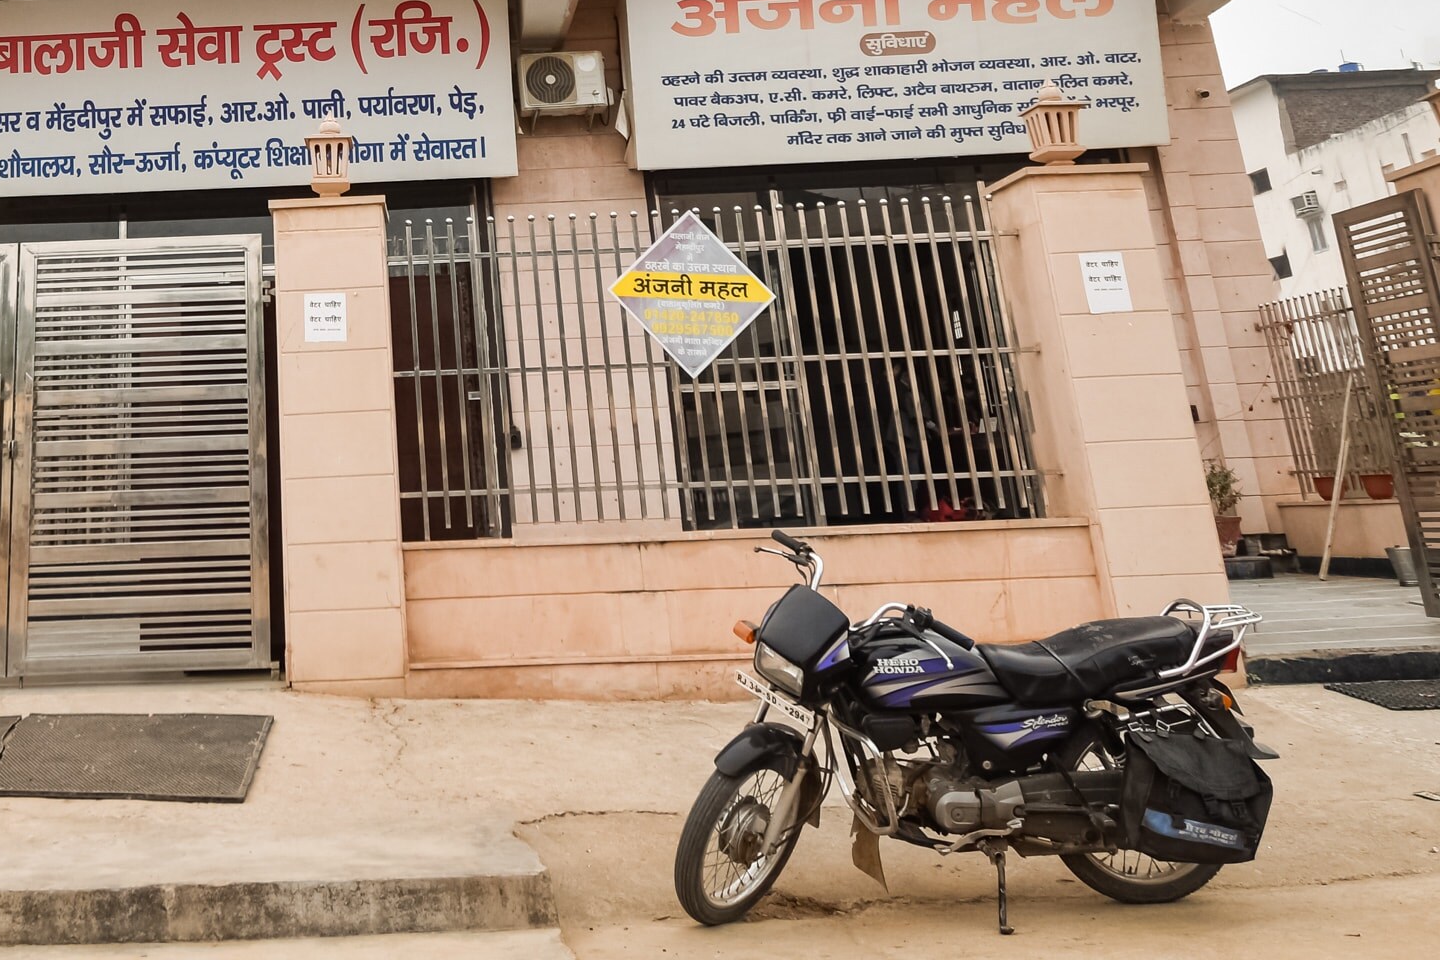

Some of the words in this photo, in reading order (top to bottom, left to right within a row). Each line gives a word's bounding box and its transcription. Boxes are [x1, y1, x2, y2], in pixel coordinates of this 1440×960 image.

[157, 12, 243, 67] सेवा
[253, 21, 337, 81] ट्रस्ट
[866, 32, 930, 54] सुविधाएं
[661, 71, 700, 87] ठहरने
[704, 69, 724, 84] की
[728, 70, 767, 83] उत्तम
[771, 68, 827, 81] व्यवस्था,
[832, 65, 859, 83] शुद्ध
[864, 59, 928, 77] शाकाहारी
[931, 58, 975, 74] भोजन
[979, 56, 1036, 71] व्यवस्था,
[1040, 54, 1072, 68] आर.
[1076, 51, 1100, 66] ओ.
[1104, 51, 1142, 65] वाटर,
[673, 95, 707, 107] पावर
[710, 91, 764, 106] बैकअप,
[768, 88, 807, 103] ए.सी.
[811, 86, 852, 101] कमरे,
[856, 84, 898, 99] लिफ्ट,
[903, 81, 936, 97] अटैच
[1092, 72, 1133, 87] कमरे,
[25, 111, 41, 131] व
[46, 100, 123, 140] मेंहदीपुर
[126, 98, 147, 127] में
[149, 94, 213, 128] सफाई,
[220, 92, 296, 123] आर.ओ.
[302, 89, 352, 119] पानी,
[358, 87, 442, 117] पर्यावरण,
[448, 85, 485, 120] पेड़,
[671, 118, 686, 129] 24
[689, 114, 711, 129] घंटे
[714, 111, 765, 127] बिजली,
[850, 104, 914, 122] वाई-फाई
[918, 100, 948, 118] सभी
[952, 100, 1013, 120] आधुनिक
[1095, 95, 1140, 115] भरपूर,
[786, 130, 823, 146] मंदिर
[826, 132, 852, 144] तक
[857, 128, 886, 142] आने
[891, 125, 922, 141] जाने
[926, 124, 946, 139] की
[950, 125, 984, 143] मुफ्त
[988, 121, 1027, 142] सुविध
[88, 142, 187, 176] सौर-ऊर्जा,
[194, 141, 261, 180] कंप्यूटर
[265, 137, 312, 167] शिक्षा
[389, 133, 410, 162] में
[633, 273, 693, 296] अंजनी
[699, 281, 748, 300] महल
[873, 666, 925, 674] HONDA
[877, 658, 919, 666] HERO
